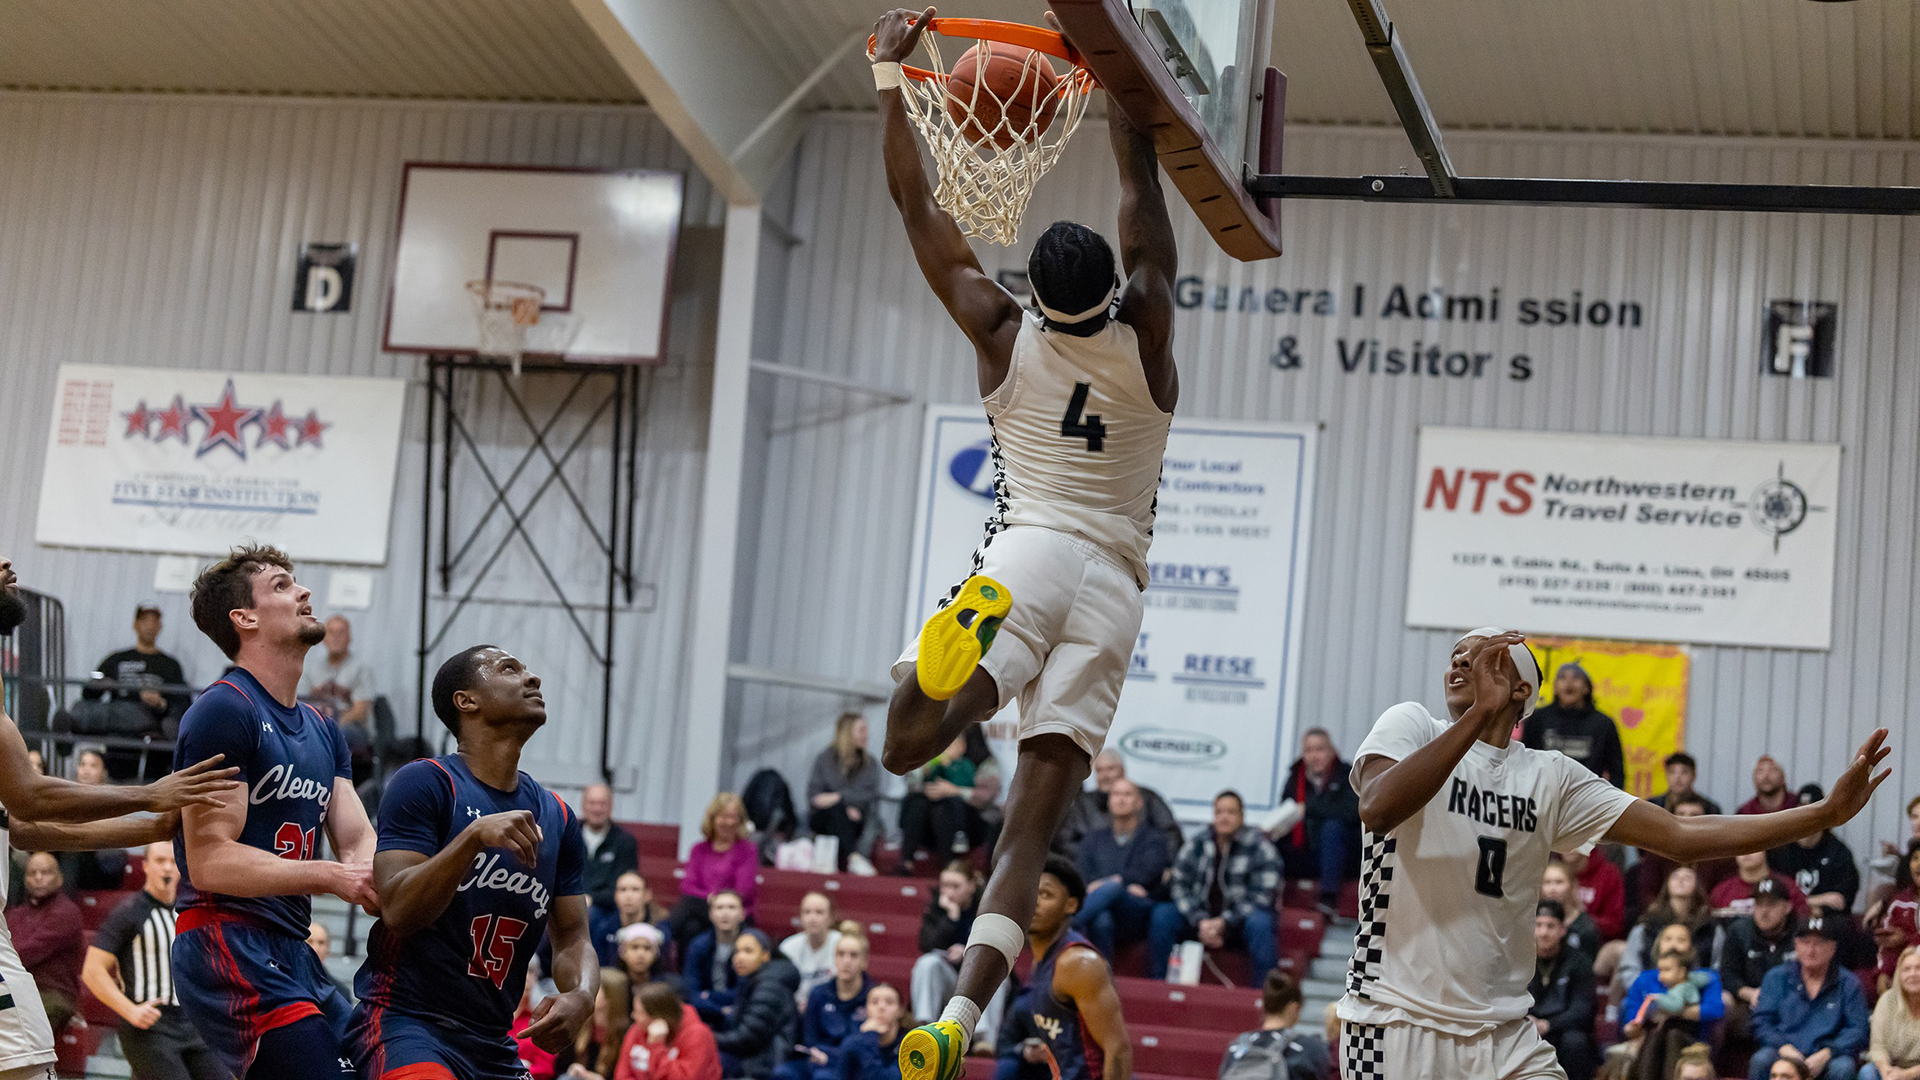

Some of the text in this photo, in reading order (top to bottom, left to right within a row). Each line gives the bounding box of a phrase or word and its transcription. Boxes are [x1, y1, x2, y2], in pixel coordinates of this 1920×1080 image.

[305, 266, 343, 310] D
[1270, 334, 1301, 370] &
[1774, 323, 1813, 372] F
[1061, 381, 1106, 452] 4
[1173, 478, 1265, 494] Contractors
[1200, 459, 1243, 473] Local
[1543, 473, 1736, 501] Northwestern
[114, 481, 321, 505] FIVE STAR INSTITUTION
[1424, 468, 1536, 516] NTS
[1544, 500, 1742, 528] Travel Service
[1185, 653, 1255, 676] REESE
[250, 764, 331, 823] Cleary
[1447, 775, 1538, 833] RACERS
[274, 822, 315, 861] 21
[457, 852, 550, 919] Cleary
[1475, 834, 1507, 899] 0
[467, 913, 529, 990] 15
